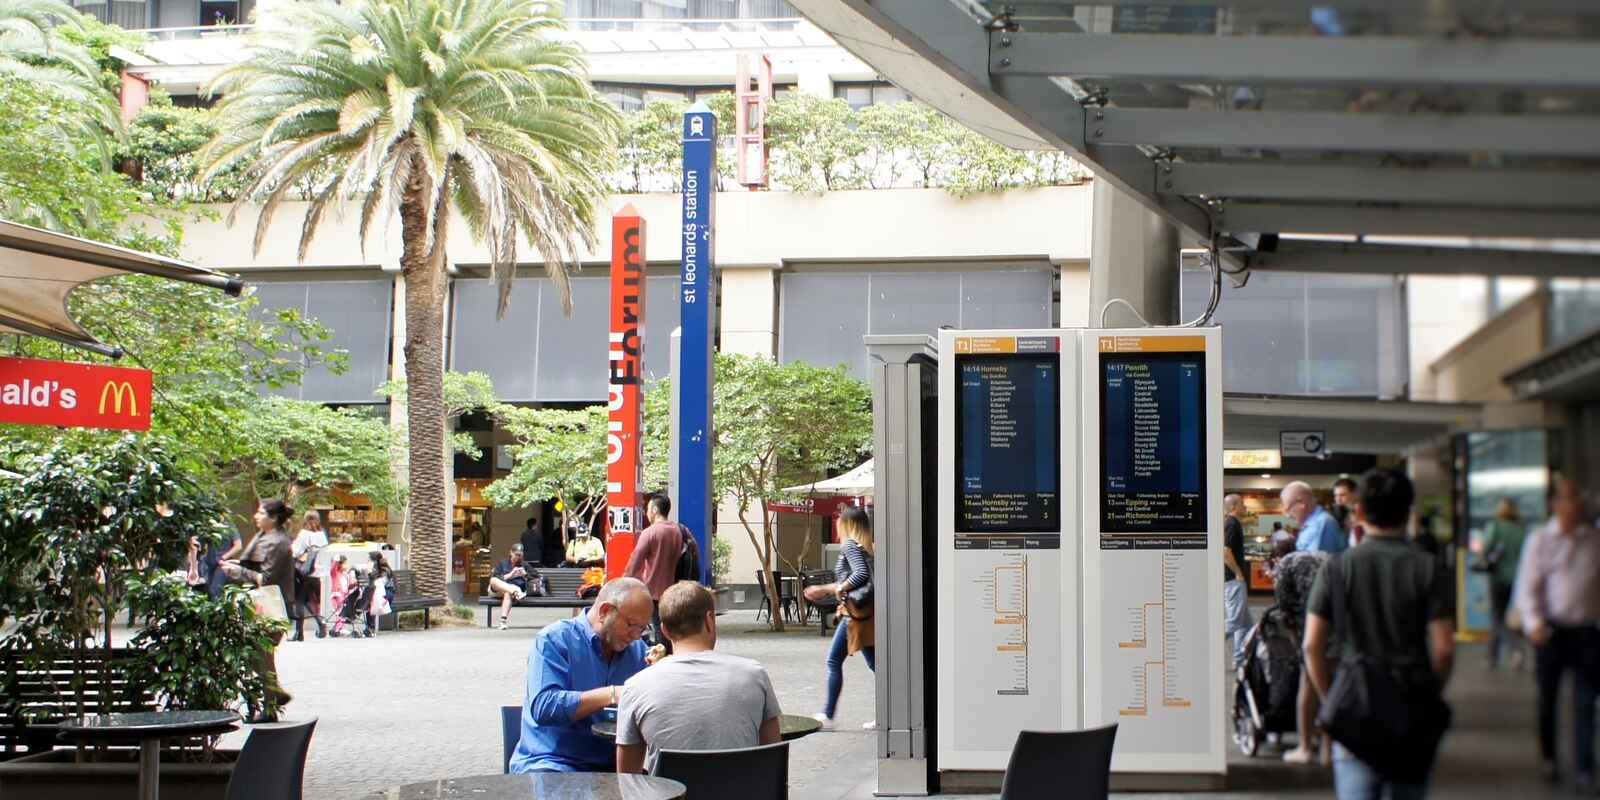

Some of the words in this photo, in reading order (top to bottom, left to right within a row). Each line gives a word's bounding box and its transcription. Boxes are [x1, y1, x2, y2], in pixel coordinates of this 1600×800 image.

[684, 170, 698, 219] station
[684, 223, 696, 284] leonards
[684, 289, 696, 304] st
[956, 340, 968, 352] T1
[1100, 338, 1113, 350] T1
[980, 365, 1007, 373] Hornsby
